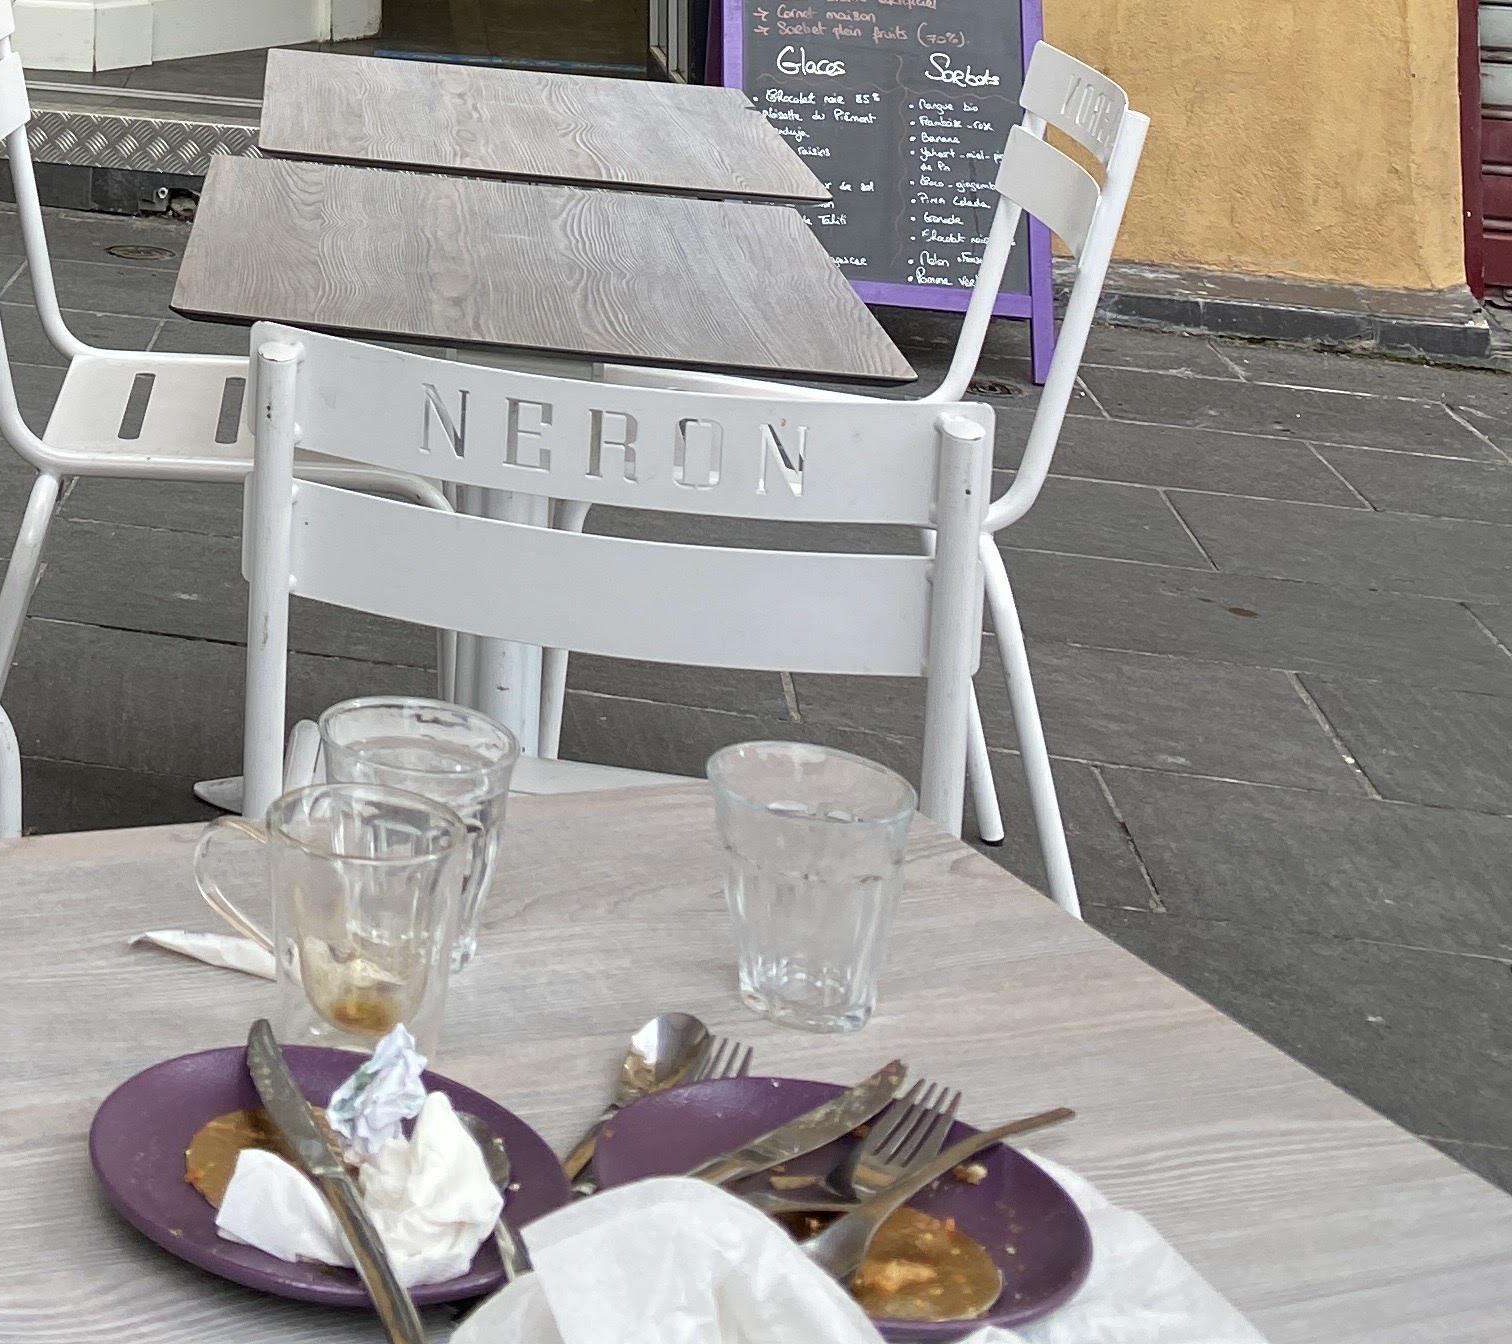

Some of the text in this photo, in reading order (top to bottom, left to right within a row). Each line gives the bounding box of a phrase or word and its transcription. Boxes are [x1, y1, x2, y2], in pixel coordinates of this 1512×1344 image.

[777, 4, 818, 19] Cornet
[777, 46, 846, 75] Glaces
[925, 52, 1001, 87] Sorbets
[766, 89, 816, 104] Chocolat
[963, 102, 978, 112] bio
[812, 110, 825, 121] du
[921, 132, 960, 143] Banane
[419, 382, 810, 498] NERON
